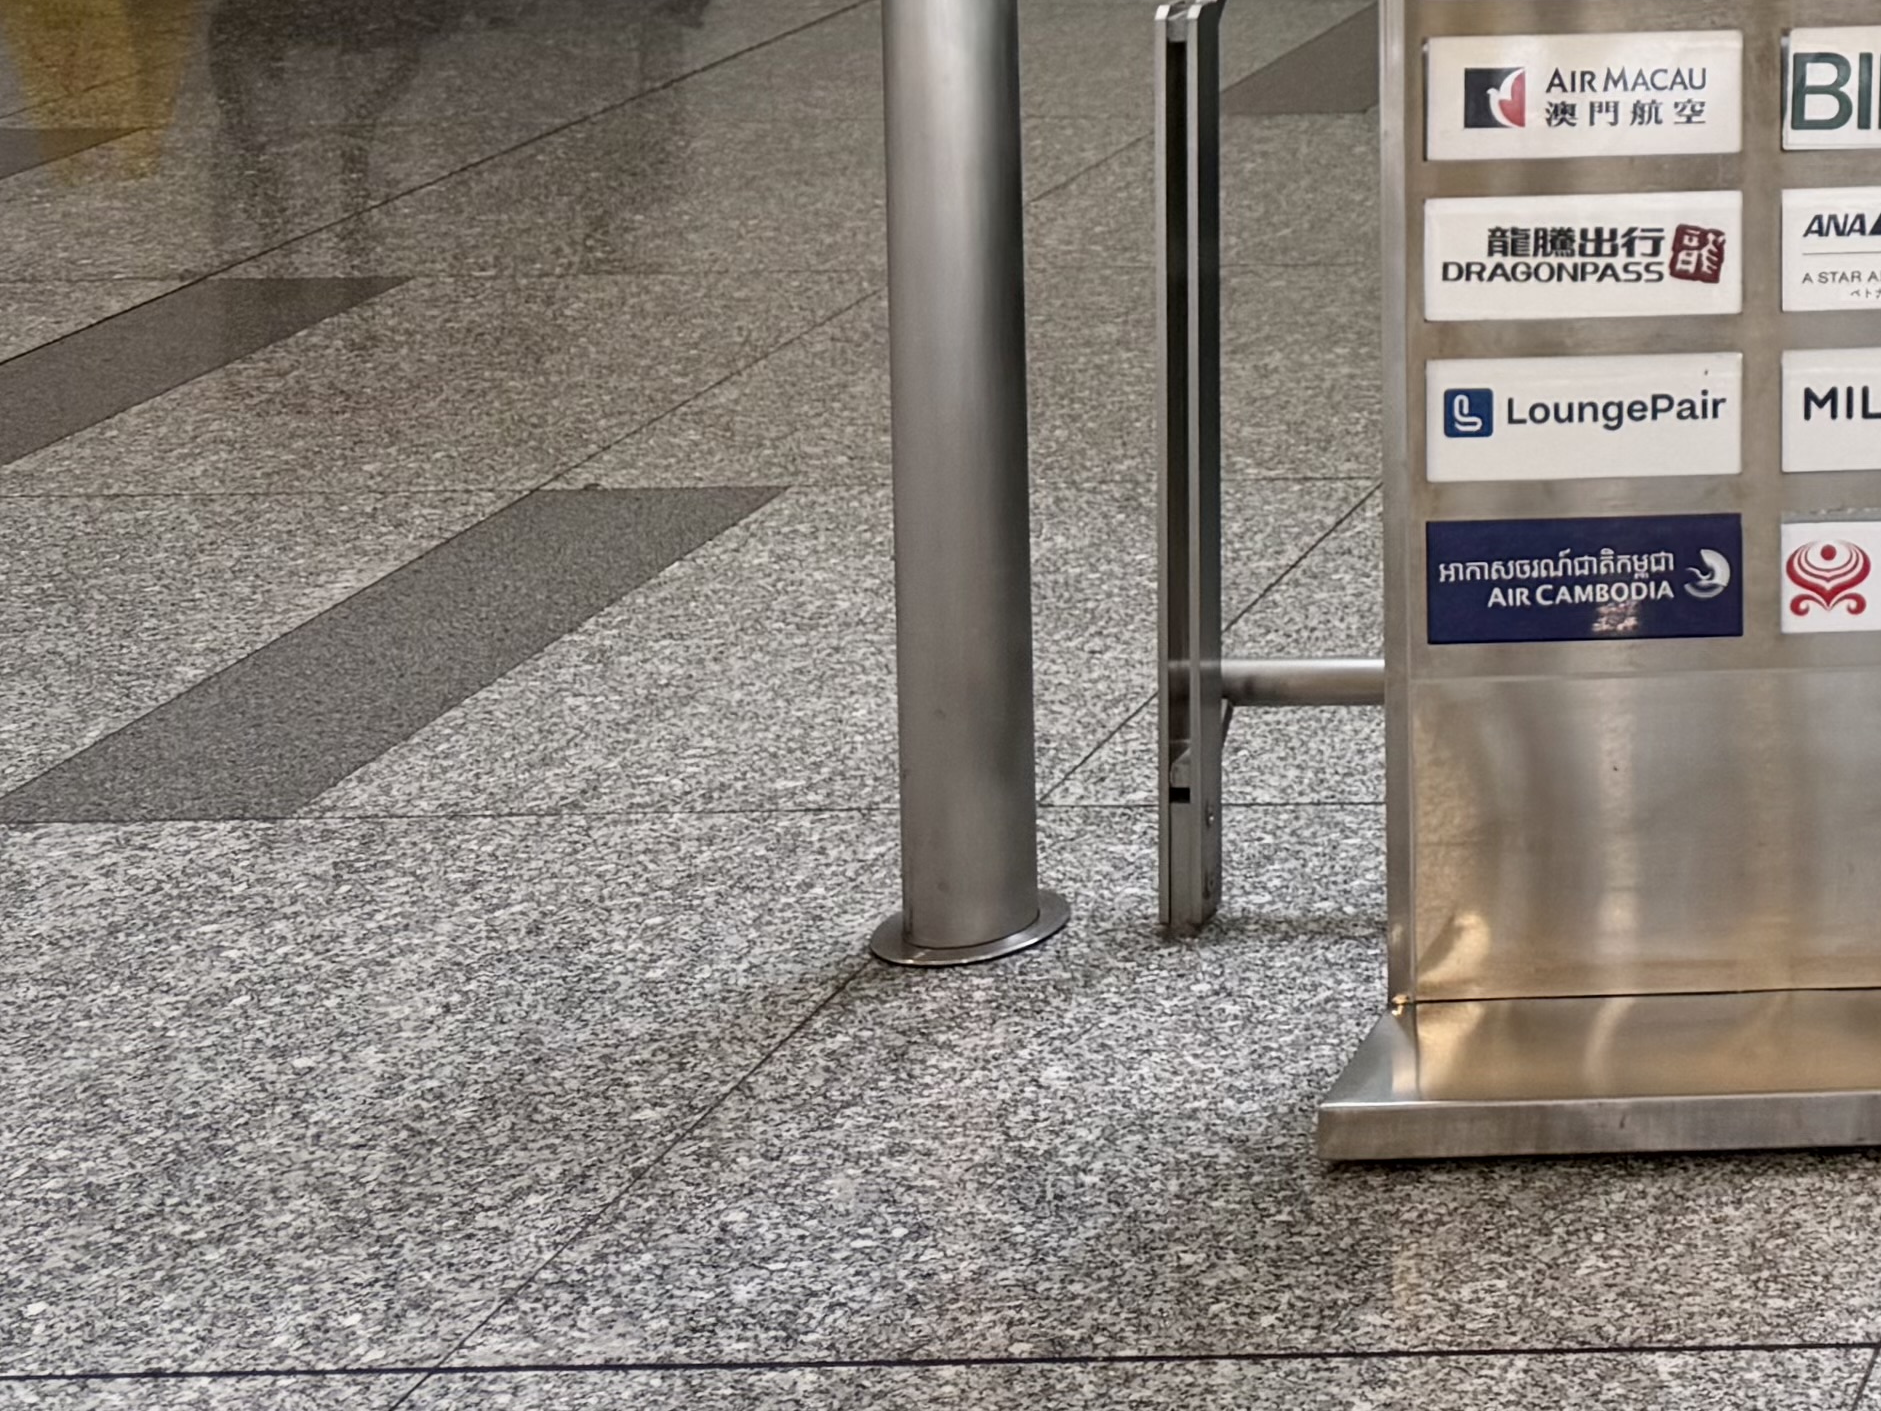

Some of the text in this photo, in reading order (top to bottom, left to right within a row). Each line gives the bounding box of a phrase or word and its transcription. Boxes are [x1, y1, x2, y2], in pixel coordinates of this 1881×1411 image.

[1546, 66, 1706, 93] AIR MACAU
[1545, 99, 1706, 126] 澳門航空
[1803, 213, 1866, 237] ANA
[1487, 226, 1665, 258] 龍騰出行
[1442, 262, 1664, 283] DRAGONPASS
[1802, 273, 1813, 284] A
[1818, 271, 1862, 284] STAR
[1507, 390, 1727, 431] LoungePair
[1488, 580, 1674, 608] AIR CAMBODIA
